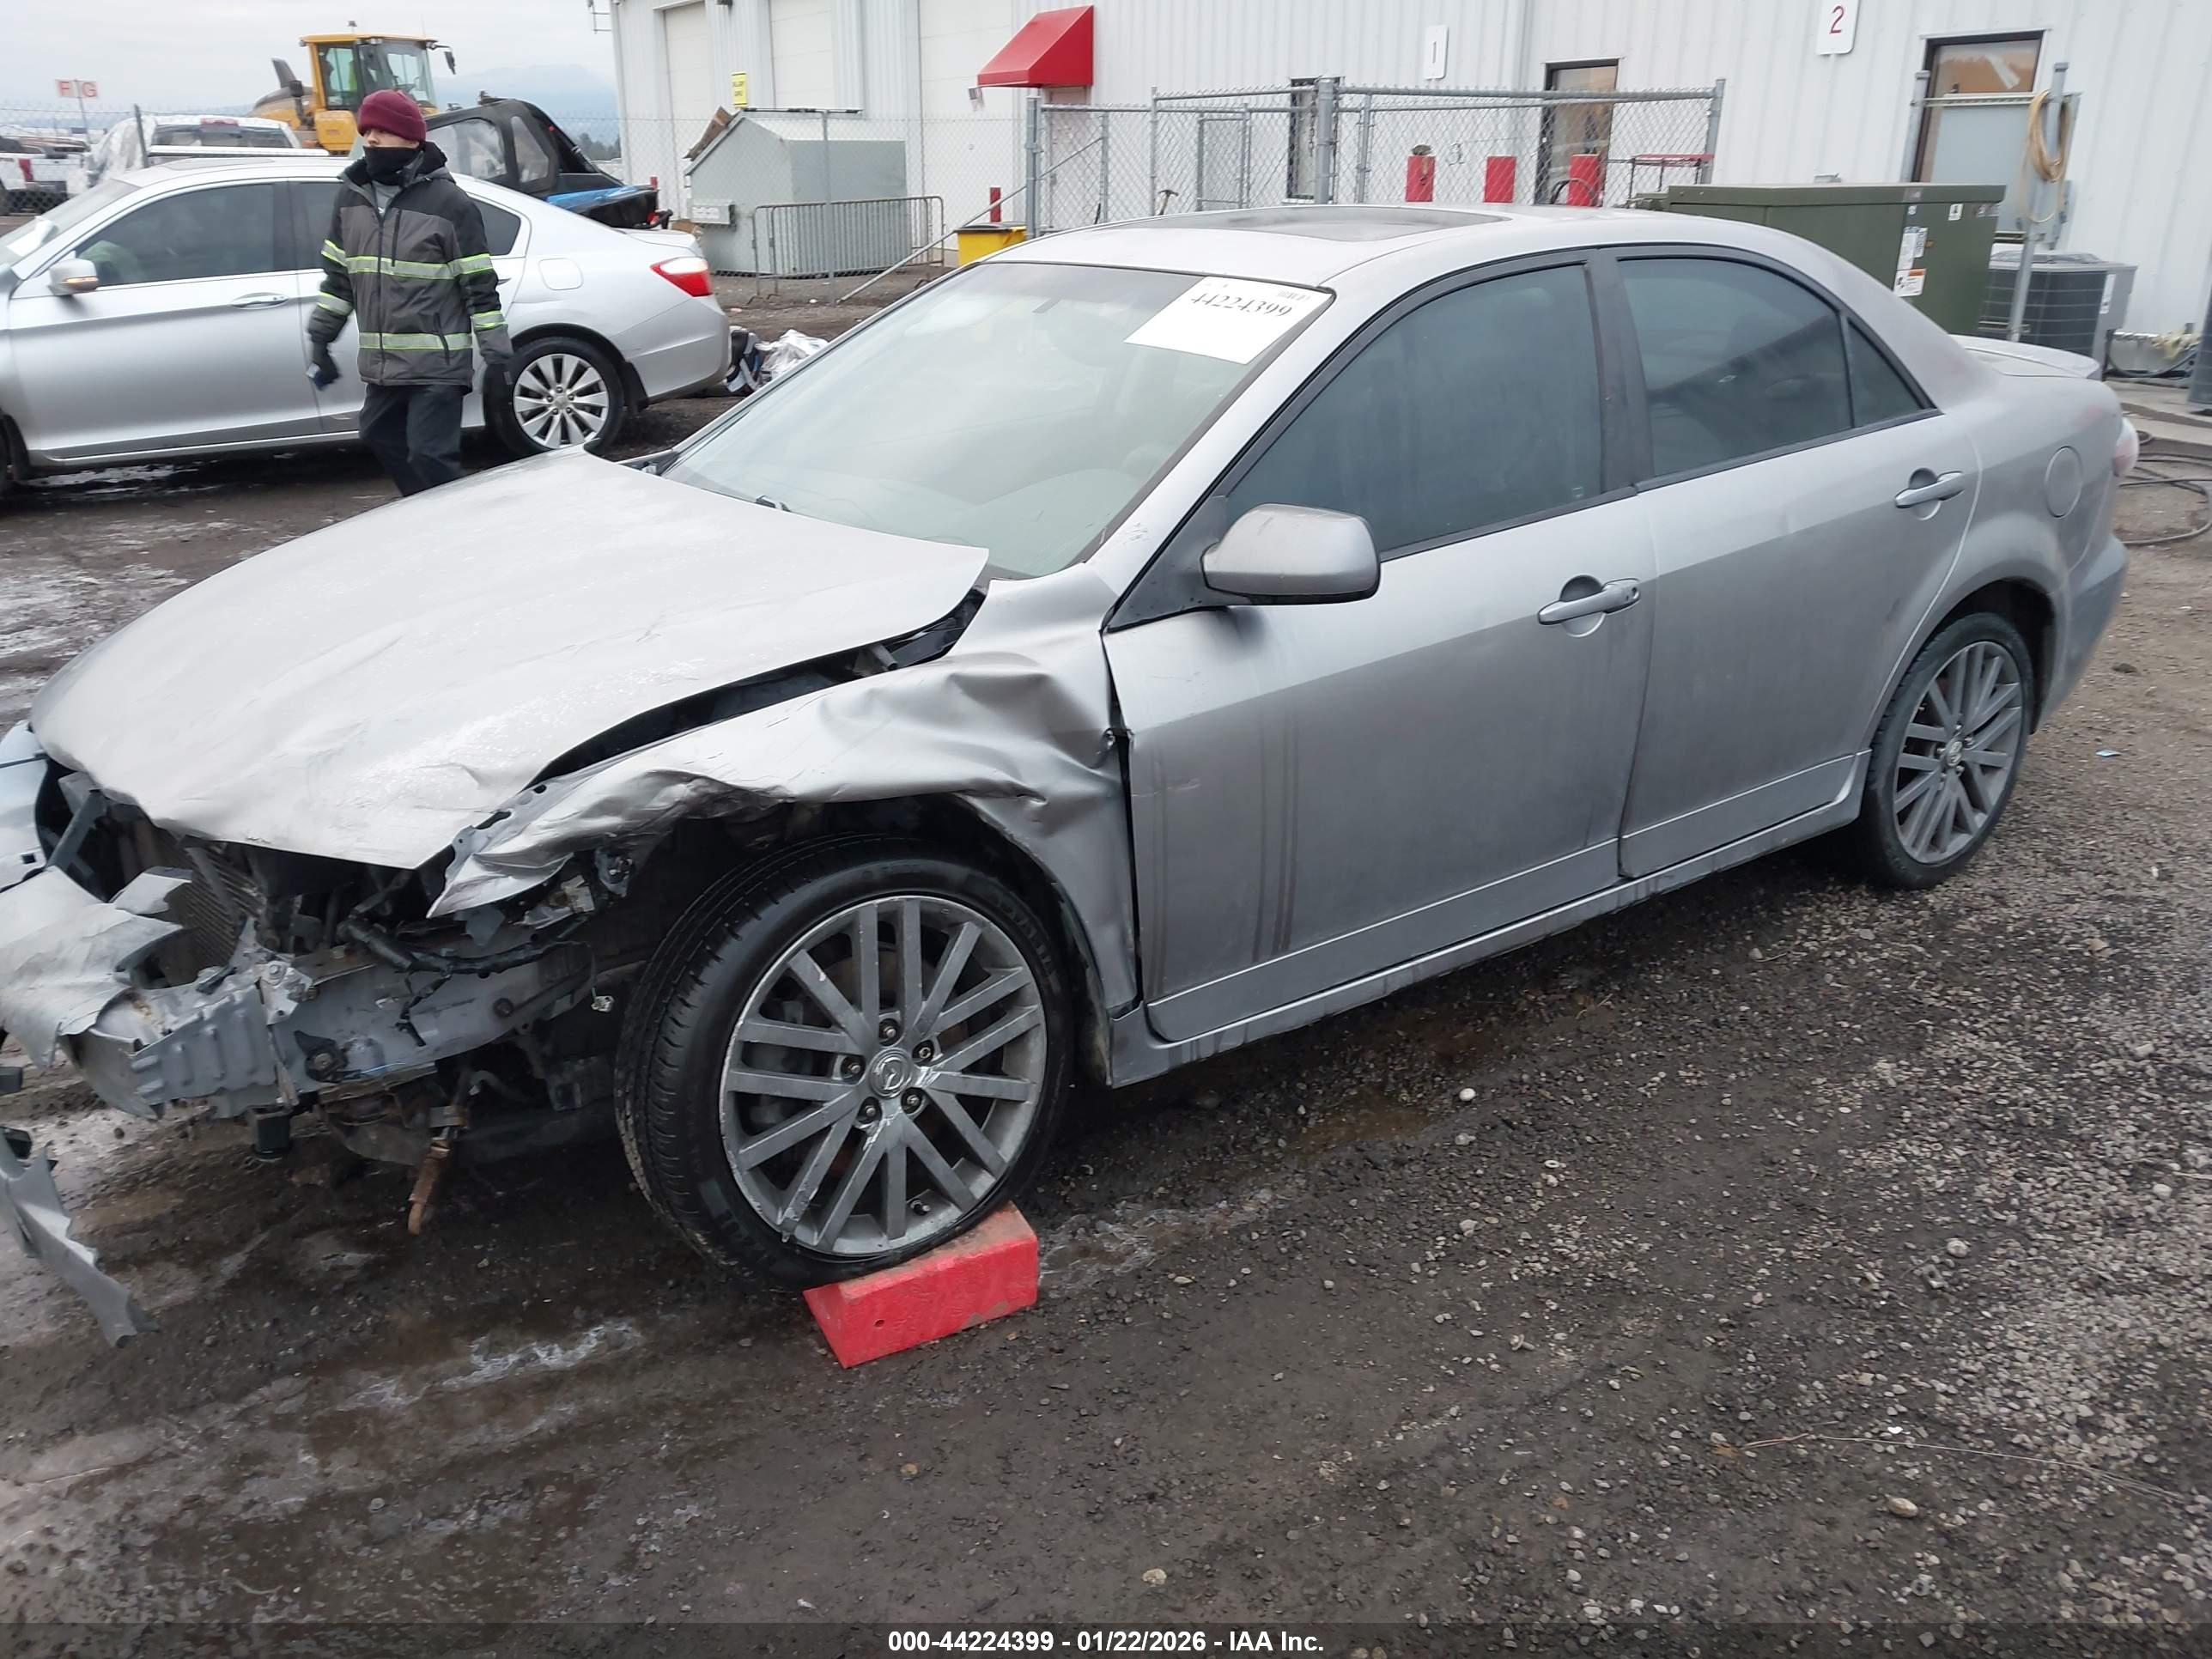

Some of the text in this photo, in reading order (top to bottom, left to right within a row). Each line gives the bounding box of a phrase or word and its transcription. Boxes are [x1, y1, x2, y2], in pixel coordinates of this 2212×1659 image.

[1829, 5, 1844, 34] 2
[82, 81, 97, 98] G
[1190, 292, 1293, 317] 44224399
